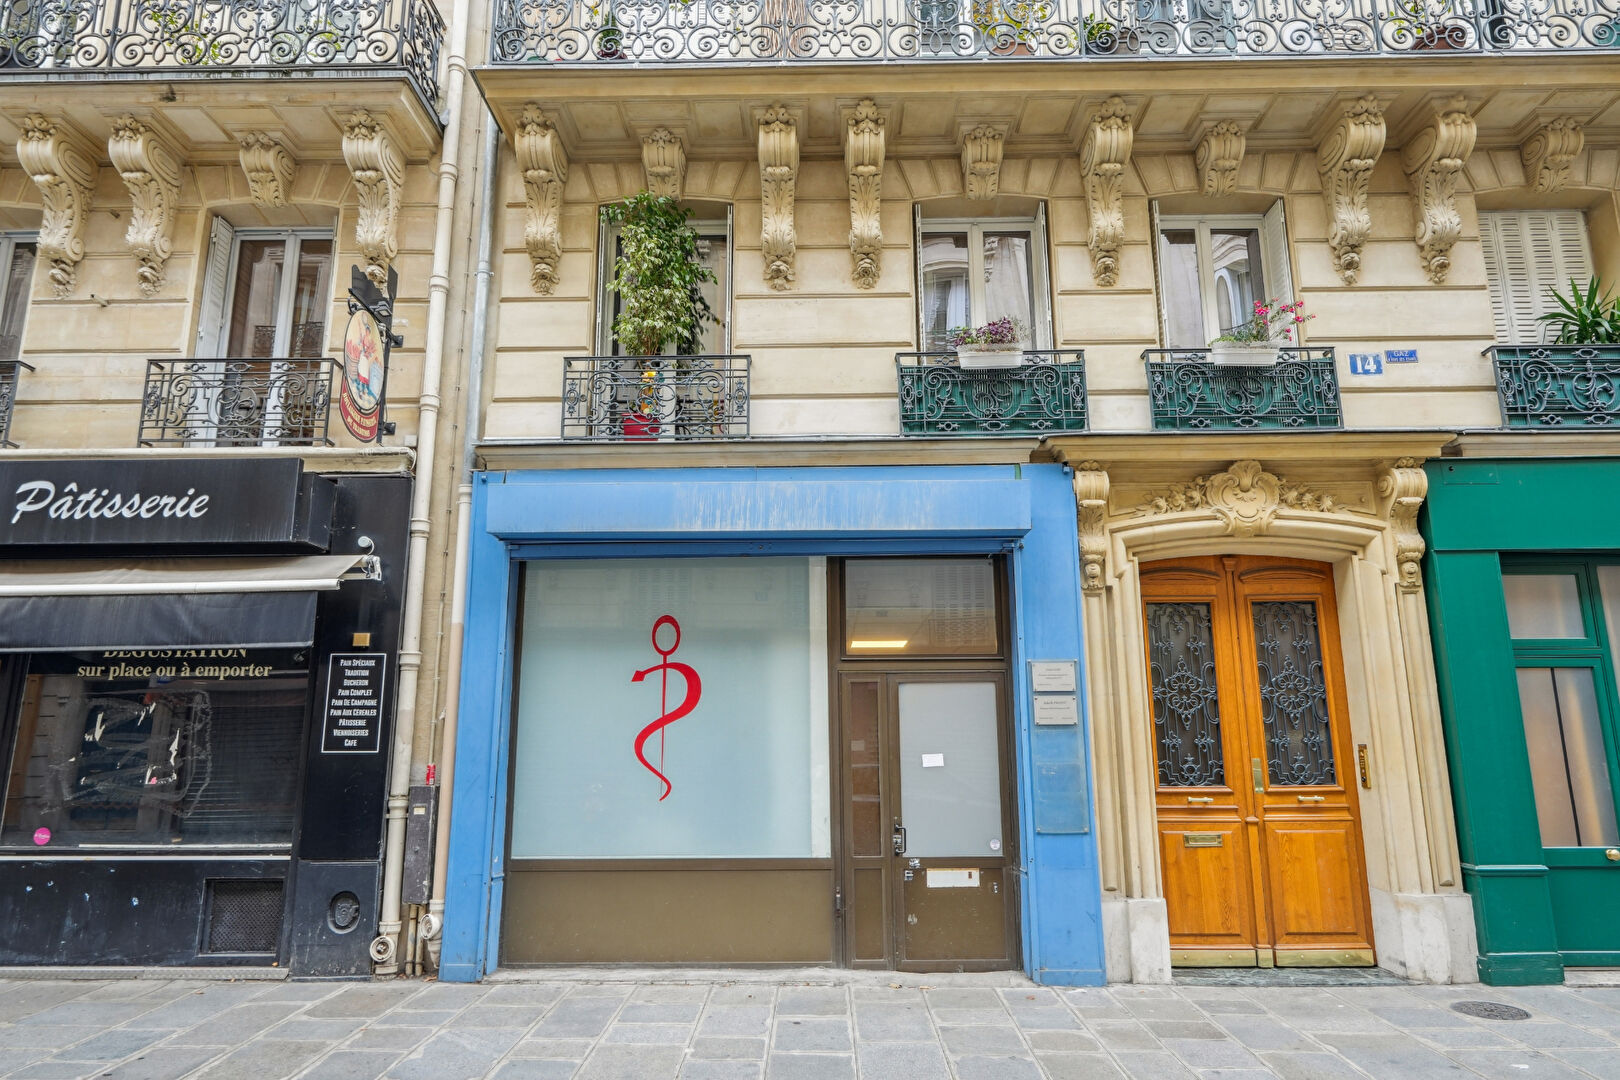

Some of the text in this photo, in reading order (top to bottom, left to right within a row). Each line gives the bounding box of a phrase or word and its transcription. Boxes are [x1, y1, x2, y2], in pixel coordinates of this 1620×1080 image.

[1355, 356, 1377, 373] 14
[11, 480, 210, 524] Pâtisserie
[77, 662, 272, 680] sur place ou à emporter
